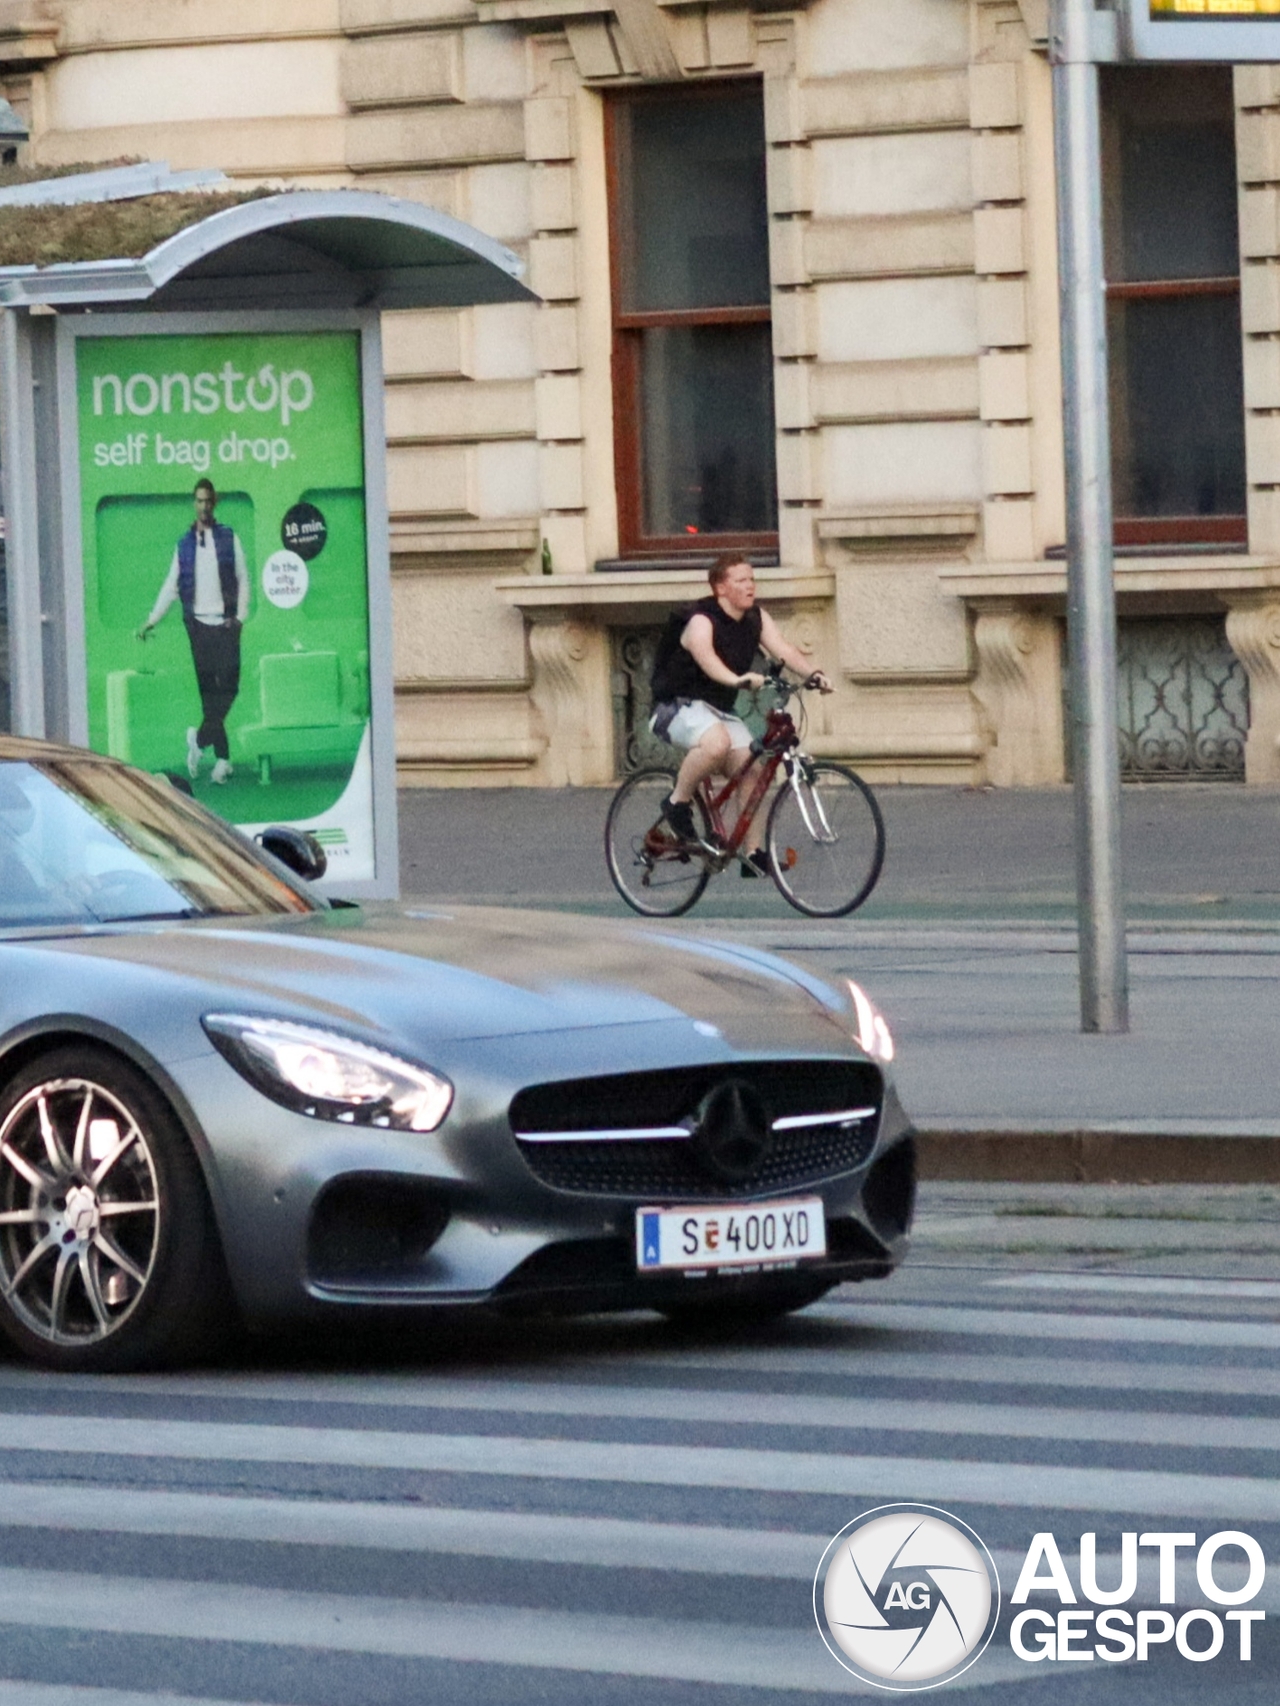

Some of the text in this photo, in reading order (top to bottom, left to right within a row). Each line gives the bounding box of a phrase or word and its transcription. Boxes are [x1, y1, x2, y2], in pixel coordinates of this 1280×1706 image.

[92, 360, 315, 427] nonstop
[93, 430, 297, 472] self bag drop.
[301, 519, 326, 535] min.
[276, 575, 294, 586] city
[283, 563, 299, 572] the
[682, 1217, 699, 1255] S
